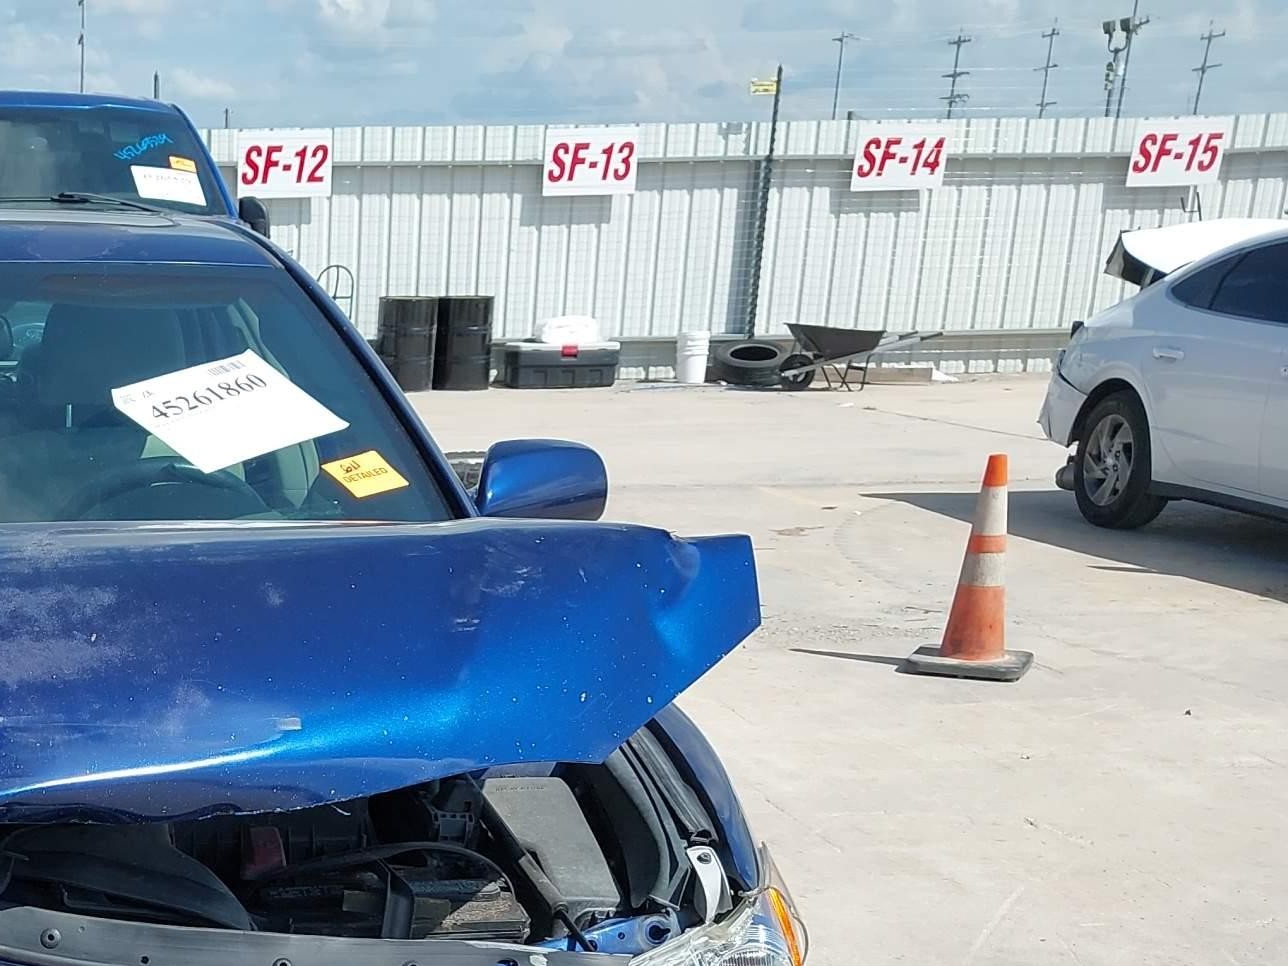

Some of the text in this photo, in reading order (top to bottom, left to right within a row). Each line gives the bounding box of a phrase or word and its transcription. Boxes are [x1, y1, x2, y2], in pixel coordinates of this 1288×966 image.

[241, 144, 329, 185] SF-12
[548, 141, 634, 183] SF-13
[857, 137, 945, 178] SF-14
[1132, 132, 1224, 173] SF-15
[152, 373, 267, 418] 45261860
[342, 467, 388, 483] DETAILED
